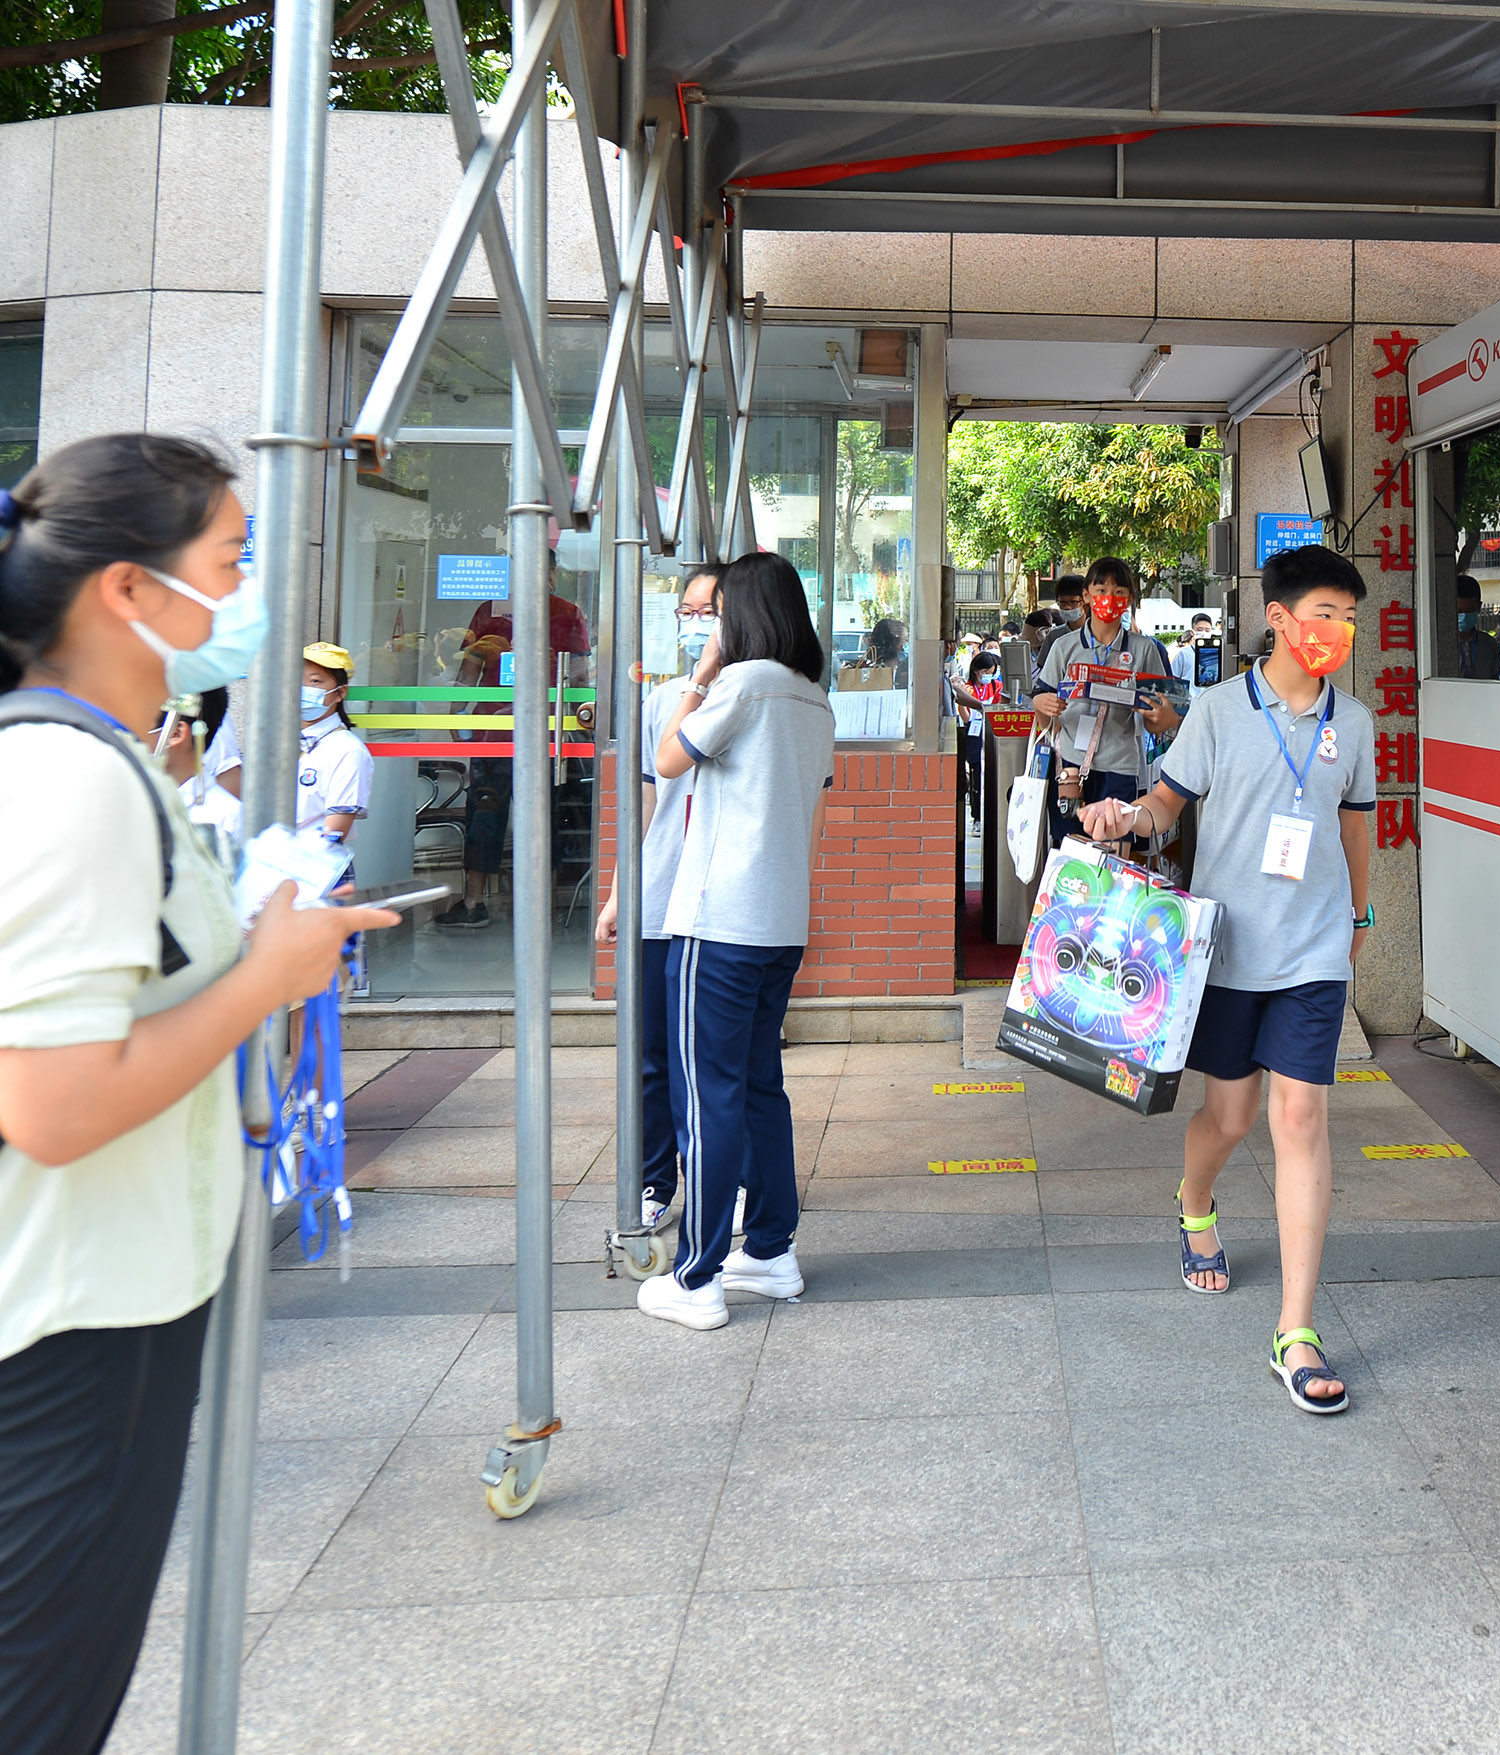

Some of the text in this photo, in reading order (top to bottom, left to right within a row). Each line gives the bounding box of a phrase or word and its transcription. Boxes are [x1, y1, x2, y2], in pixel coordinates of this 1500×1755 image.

[993, 714, 1034, 722] 保持距
[1373, 329, 1422, 850] 文明礼让自觉排队
